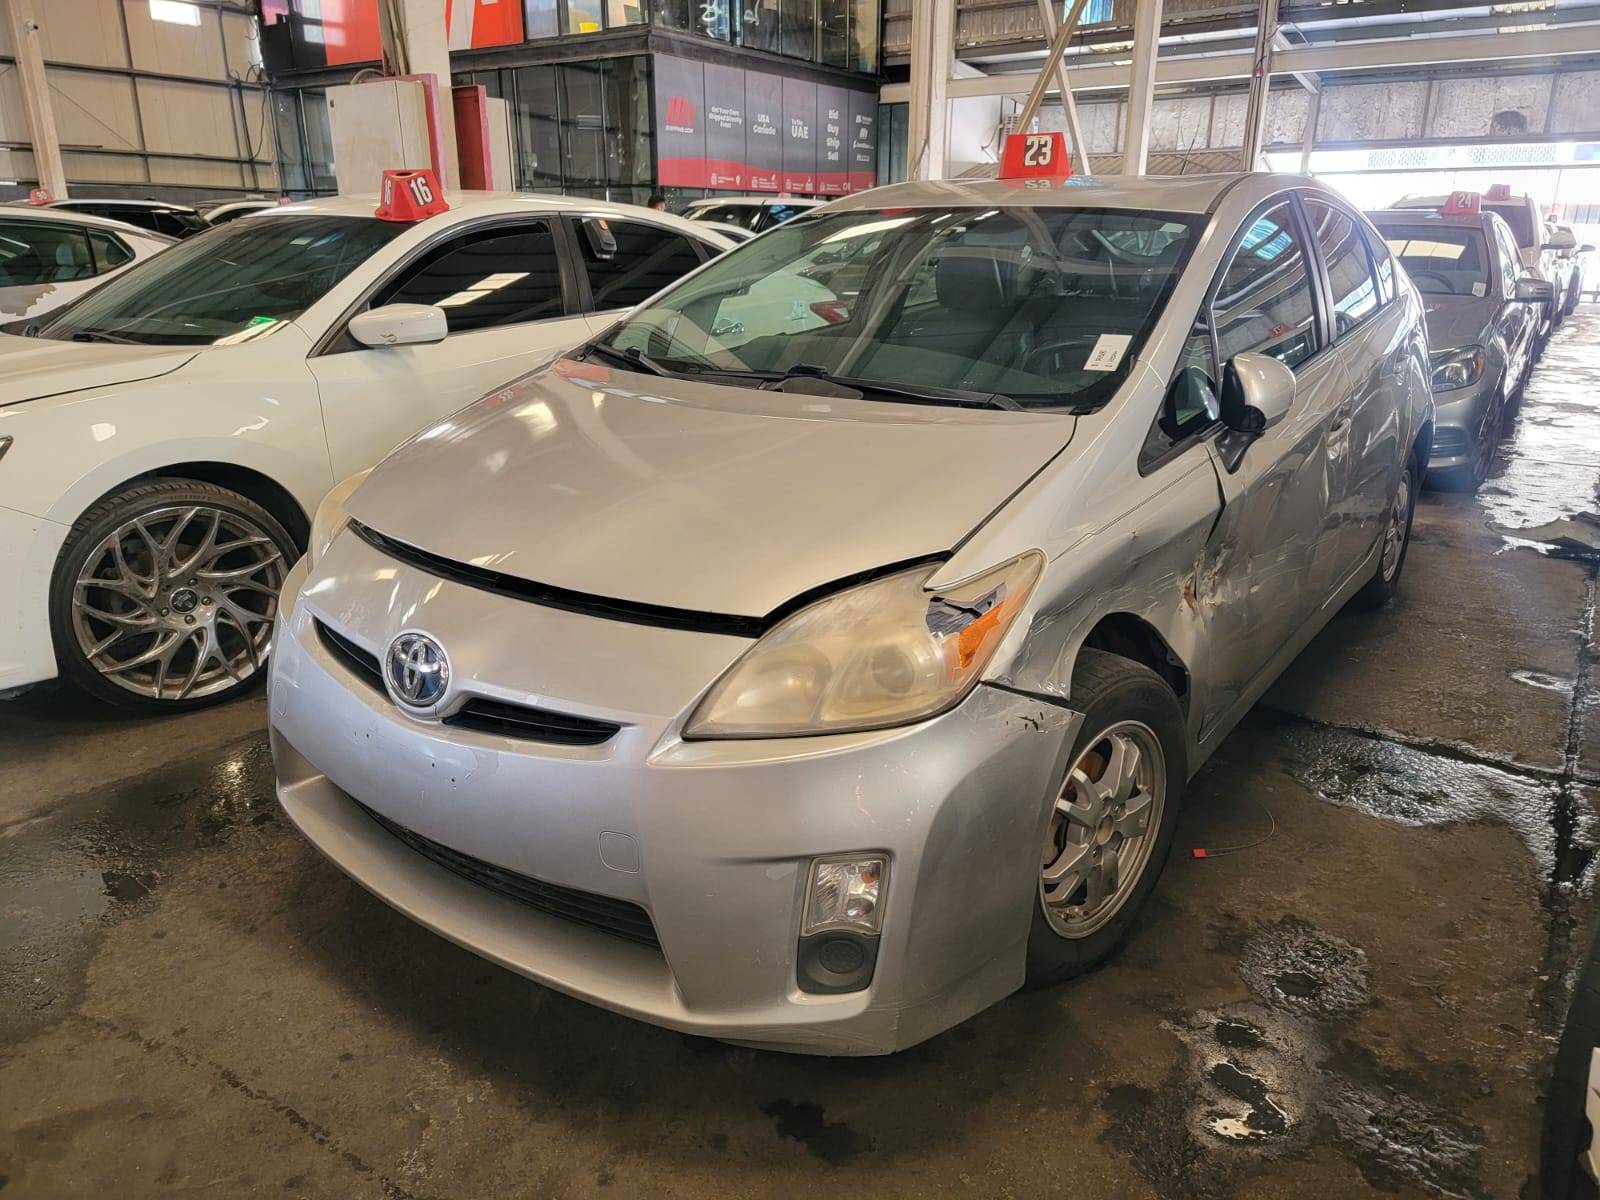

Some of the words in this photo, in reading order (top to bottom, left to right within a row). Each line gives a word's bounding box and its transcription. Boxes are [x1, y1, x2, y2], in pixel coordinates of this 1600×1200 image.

[758, 113, 770, 123] USA
[829, 109, 839, 119] Bid
[752, 124, 776, 136] Canada
[791, 125, 809, 139] UAE
[827, 123, 840, 136] Buy
[826, 137, 841, 150] Ship
[827, 151, 839, 161] Sell
[1024, 135, 1053, 167] 23
[384, 177, 392, 206] 16
[410, 176, 433, 206] 16
[1458, 193, 1472, 208] 24
